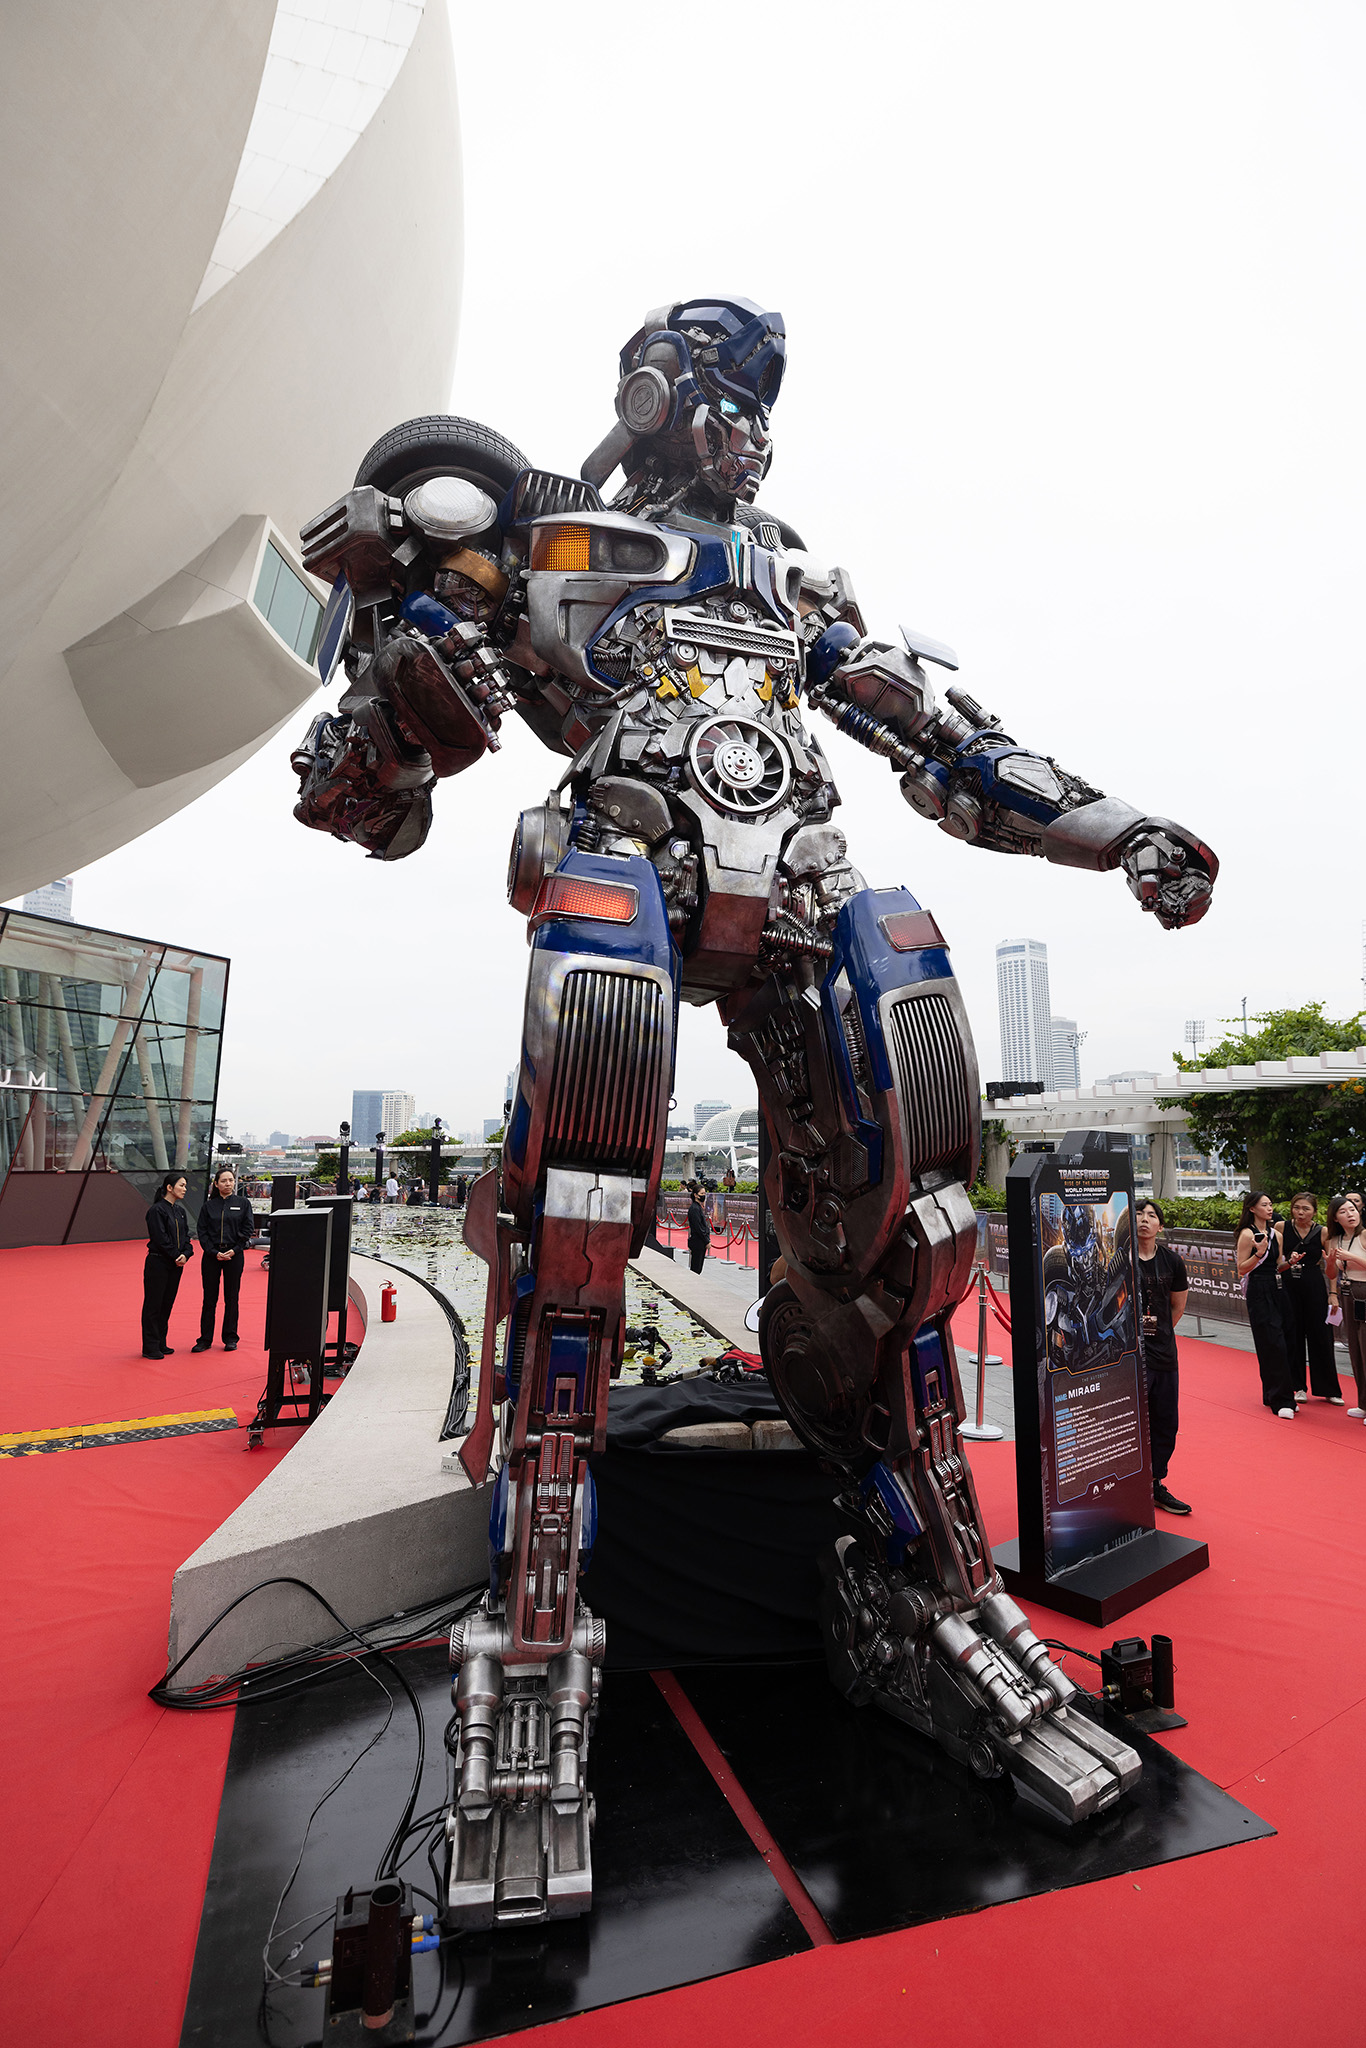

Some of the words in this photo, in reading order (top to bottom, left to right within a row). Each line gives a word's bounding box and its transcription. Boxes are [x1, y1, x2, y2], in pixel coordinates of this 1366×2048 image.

[1058, 1169, 1110, 1180] TRANSFORMERS
[1211, 1268, 1224, 1277] OF
[1068, 1382, 1101, 1399] MIRAGE
